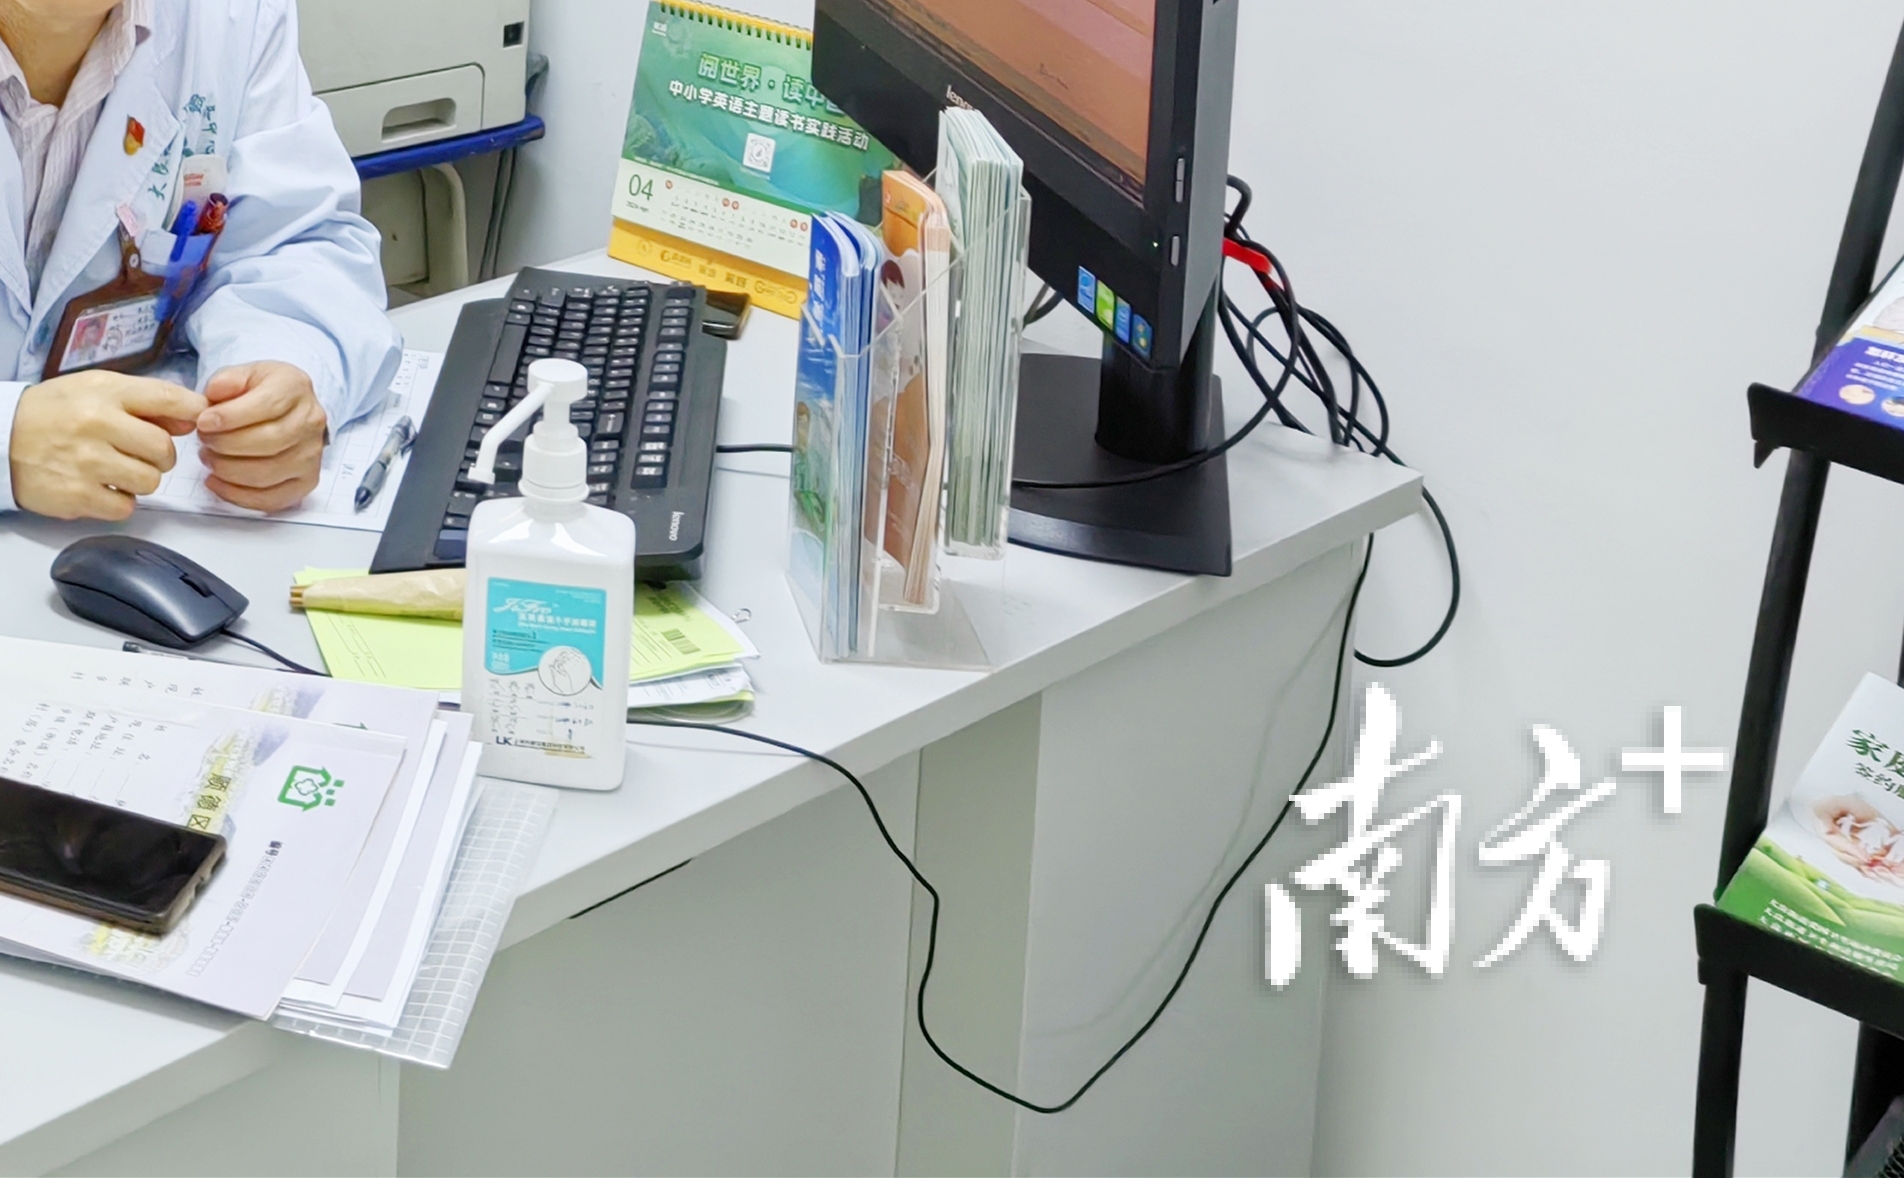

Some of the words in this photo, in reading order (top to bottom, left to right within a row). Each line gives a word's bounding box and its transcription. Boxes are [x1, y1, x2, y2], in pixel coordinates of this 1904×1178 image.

[668, 78, 870, 152] 中小学英语主题读书实践活动
[628, 173, 655, 201] 04
[668, 511, 685, 541] lenovo
[185, 772, 232, 831] 顺德区
